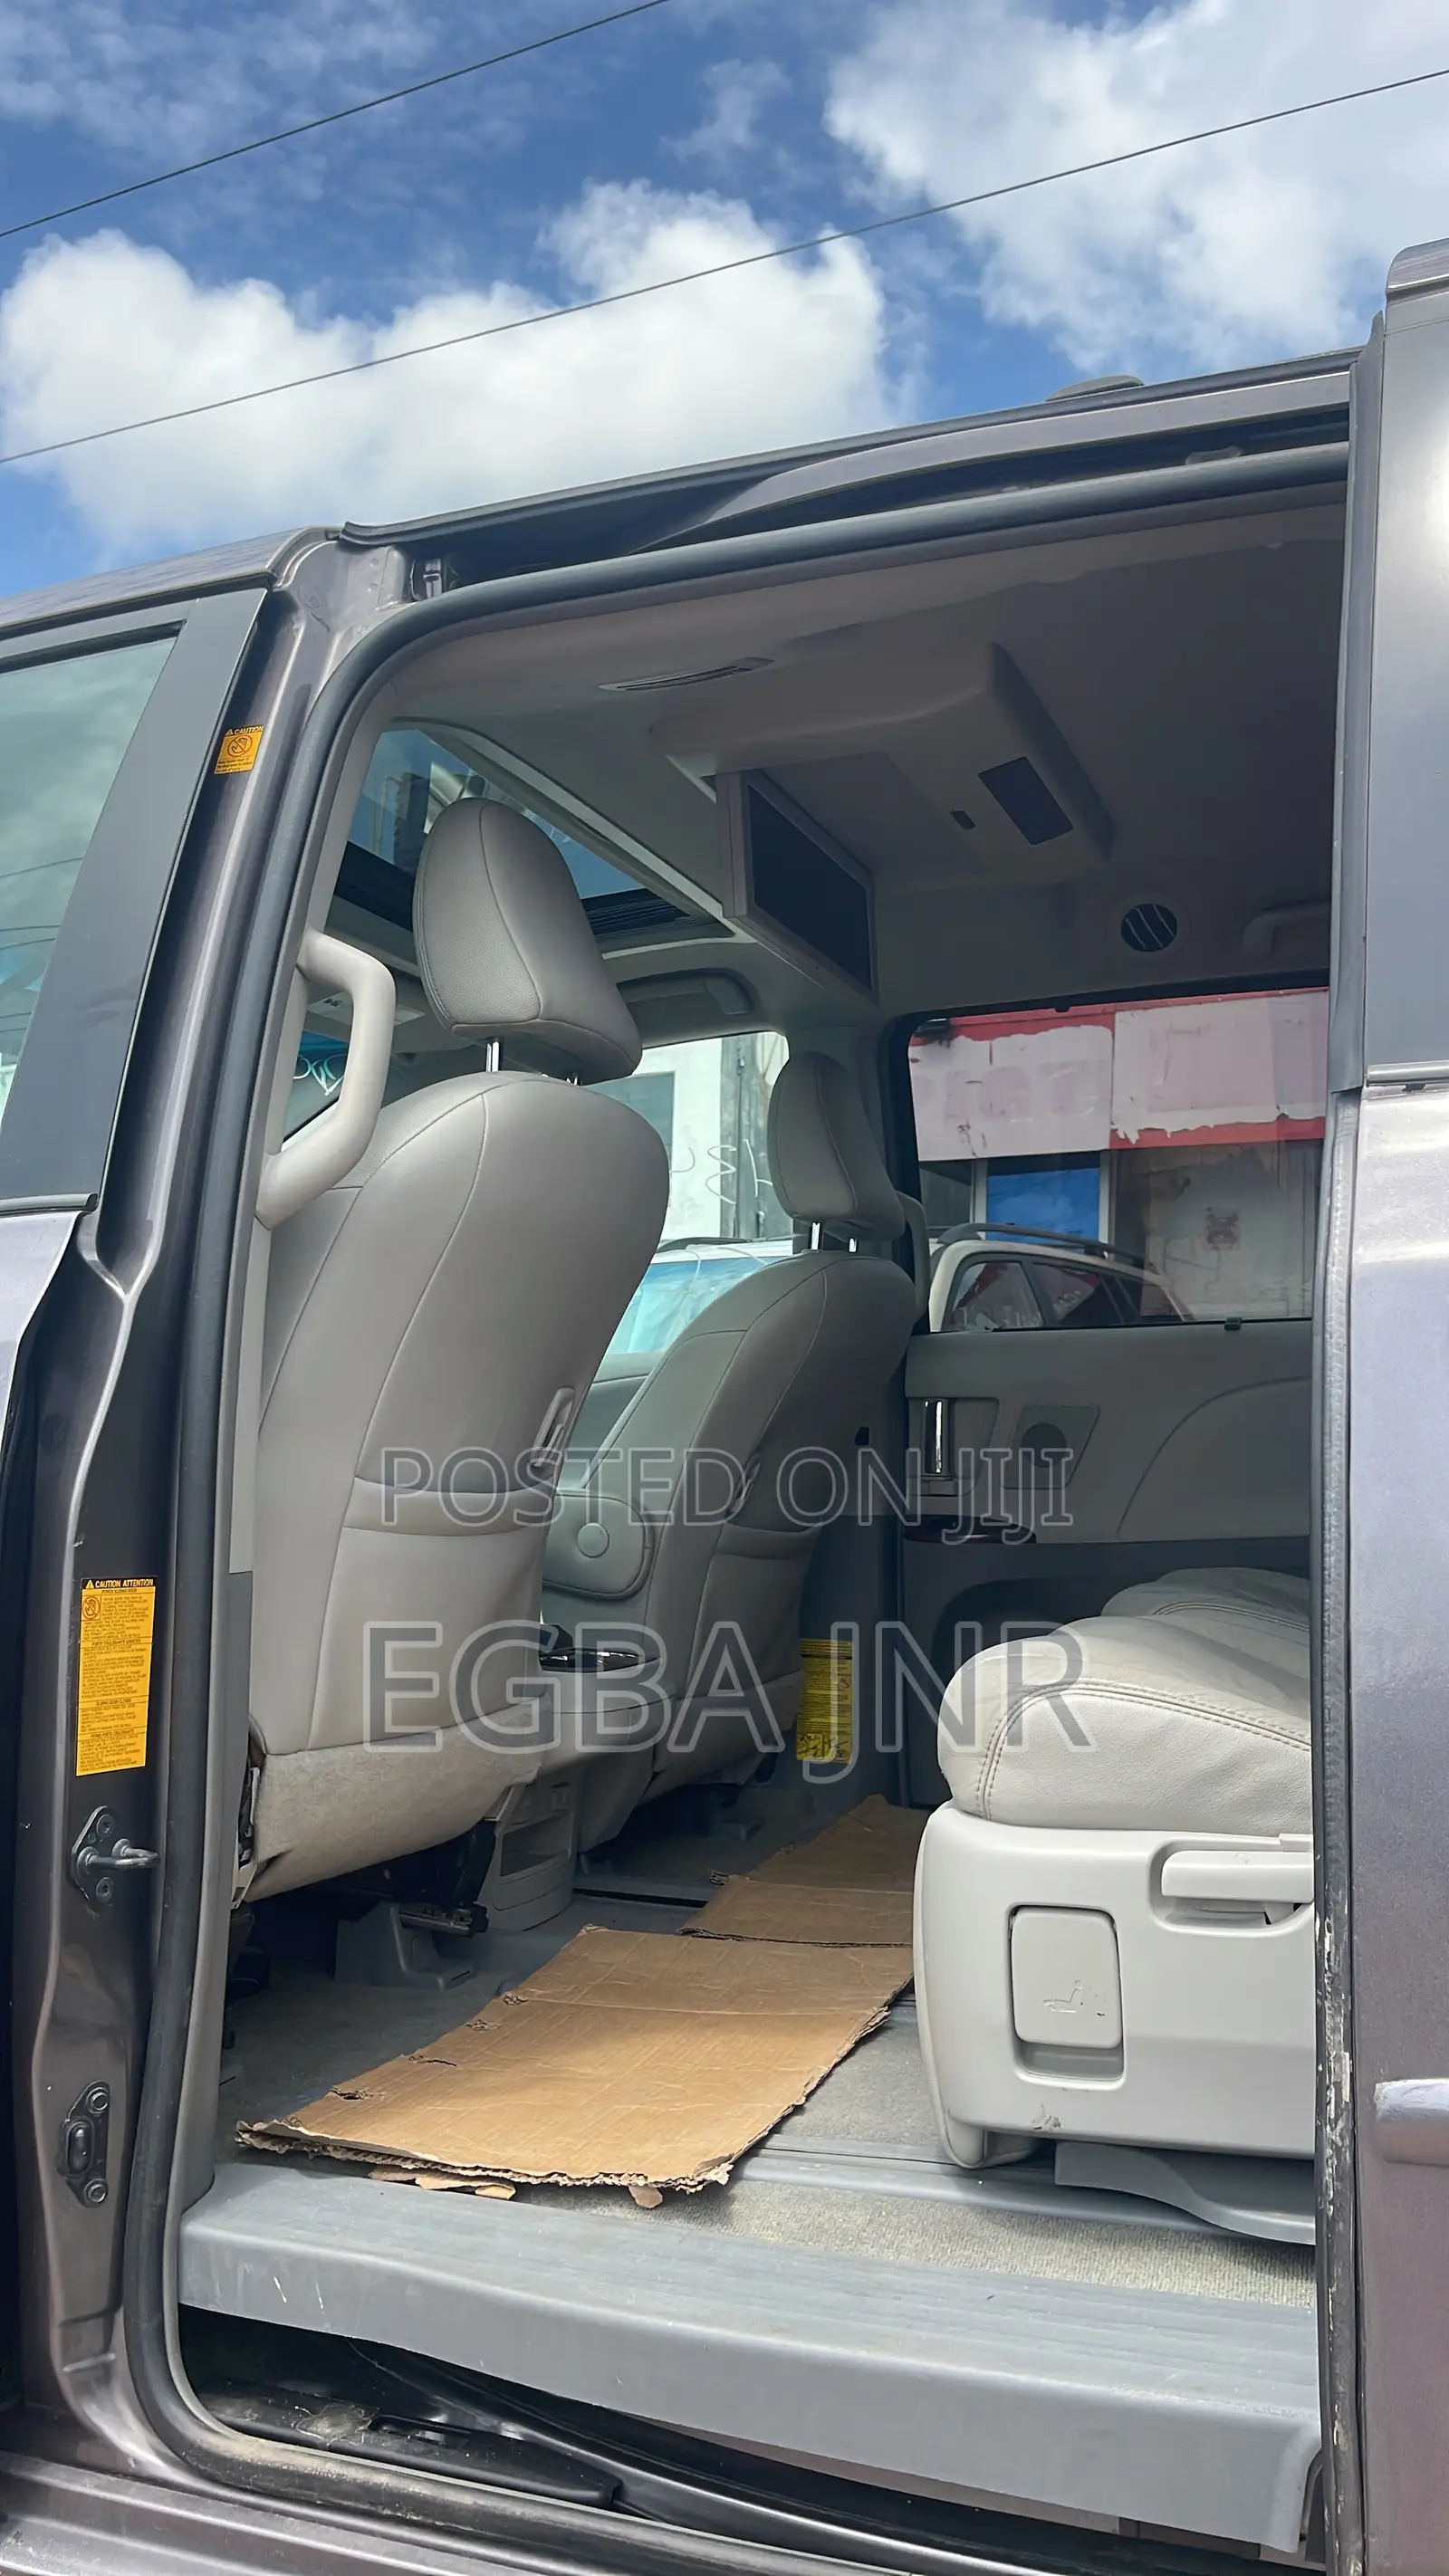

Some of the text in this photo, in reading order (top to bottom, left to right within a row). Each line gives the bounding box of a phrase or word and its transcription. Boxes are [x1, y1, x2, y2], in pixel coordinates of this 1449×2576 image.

[234, 725, 264, 735] CAUTION
[95, 1578, 154, 1589] CAUTION ATTENTION
